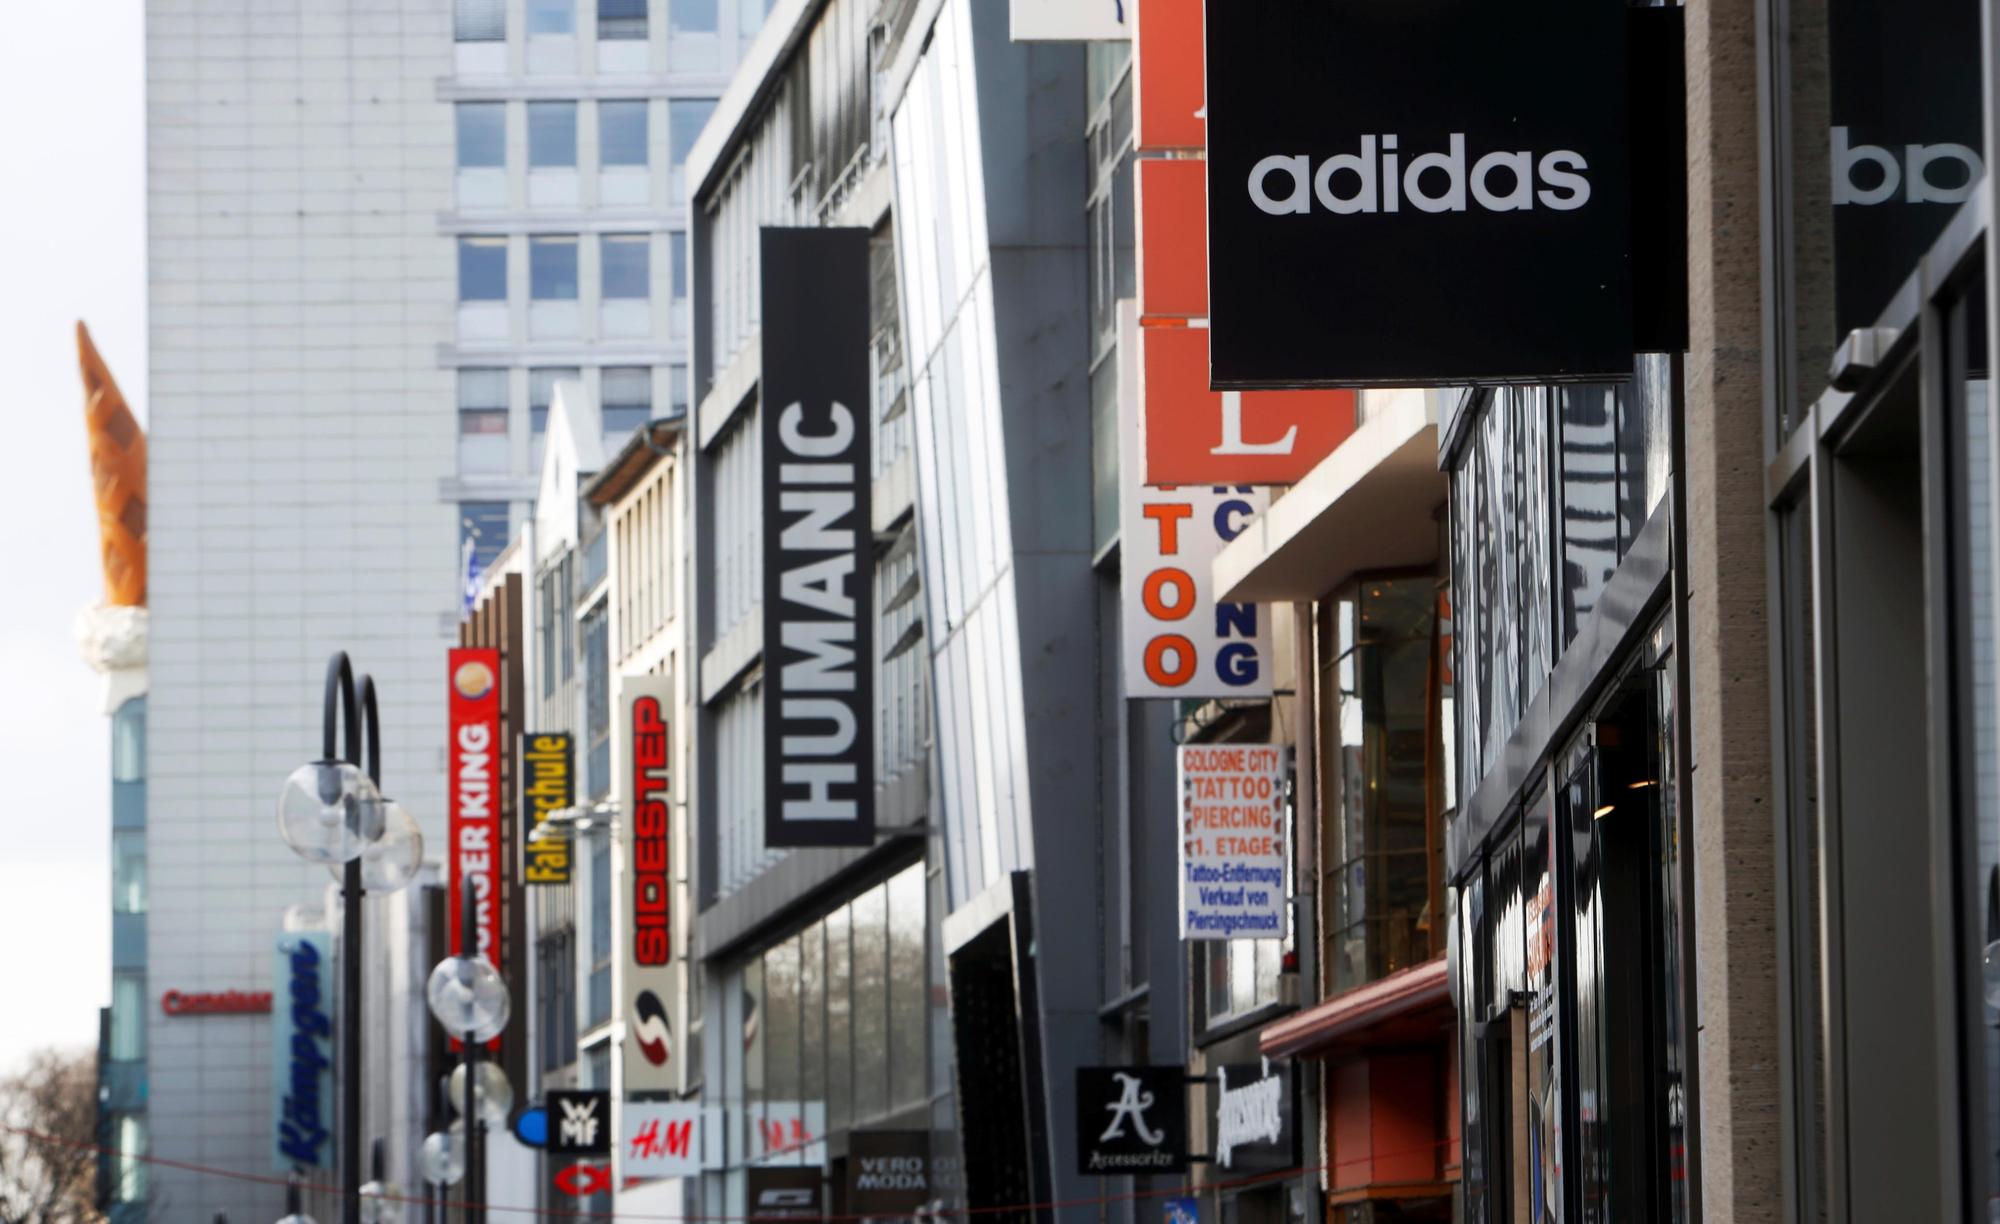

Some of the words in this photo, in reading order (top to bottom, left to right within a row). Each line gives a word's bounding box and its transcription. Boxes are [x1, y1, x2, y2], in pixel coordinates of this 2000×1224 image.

[1247, 132, 1592, 215] adidas
[1142, 487, 1197, 687] TOO
[778, 400, 858, 821] HUMANIC
[458, 723, 491, 819] KING
[1184, 751, 1245, 772] COLOGNE
[1248, 751, 1279, 772] CITY
[1193, 777, 1272, 799] TATTOO
[525, 735, 569, 882] Fahchule
[1193, 806, 1272, 829] PIERCING
[632, 695, 670, 967] SIDESTEP
[1195, 838, 1210, 856] 1.
[1216, 837, 1272, 856] ETAGE
[1185, 862, 1281, 887] Tattoo-Entfernung
[1199, 886, 1244, 906] Verkauf
[1248, 891, 1268, 906] von
[1187, 910, 1278, 935] Piercingschmuck
[630, 1118, 693, 1160] H&M
[860, 1156, 924, 1172] VERO
[1088, 1149, 1174, 1169] Accessorize
[857, 1173, 927, 1190] MODA
